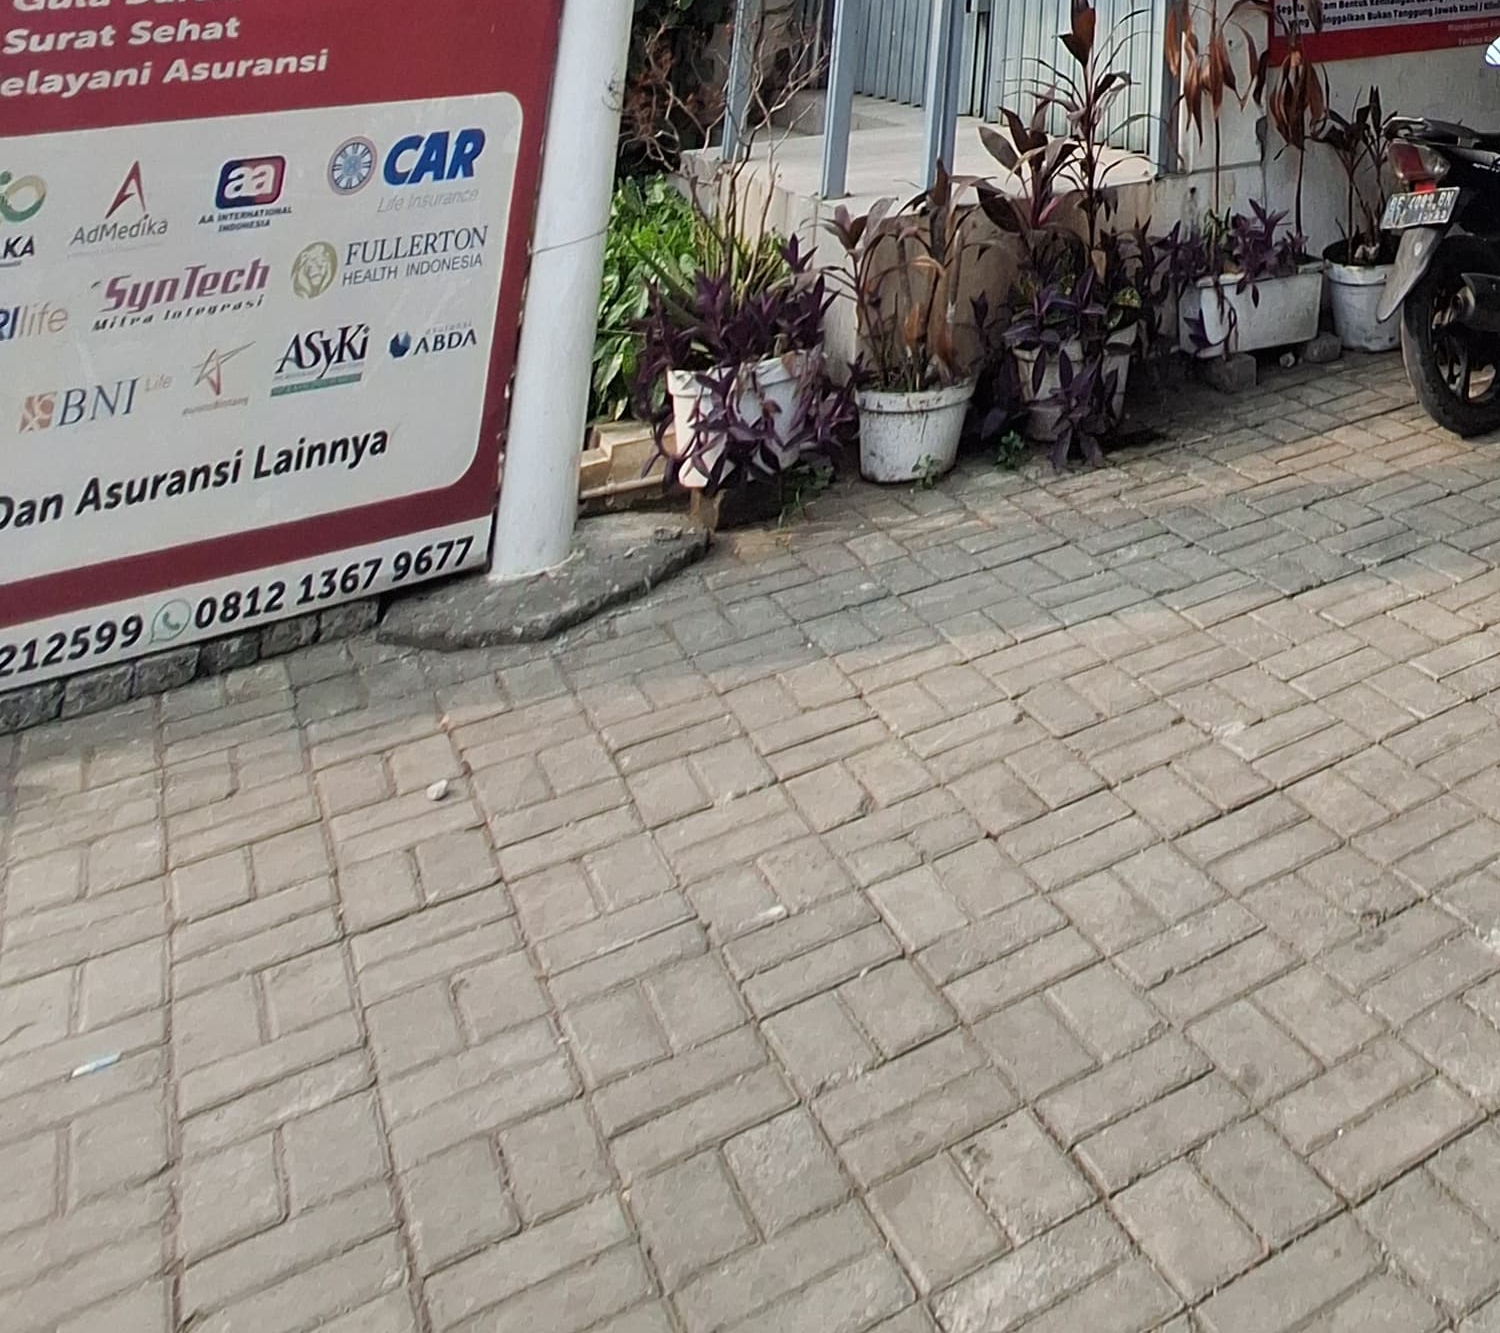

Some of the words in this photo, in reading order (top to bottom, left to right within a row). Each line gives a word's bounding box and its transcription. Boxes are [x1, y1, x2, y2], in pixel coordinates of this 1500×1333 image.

[3, 24, 116, 55] Surat
[128, 17, 241, 45] Sehat
[163, 49, 328, 83] Asuransi
[383, 128, 487, 187] CAR
[70, 213, 168, 246] AdMedika
[345, 225, 489, 265] FULLERTON
[100, 258, 271, 314] SynTech
[342, 265, 398, 286] HEALTH
[405, 253, 482, 278] INDONESIA
[413, 329, 477, 355] ABDA
[57, 378, 141, 426] BNI
[0, 495, 63, 530] Dan
[75, 449, 243, 517] Asuransi
[253, 430, 389, 480] Lainnya
[194, 580, 285, 629] 0812
[296, 557, 384, 606] 1367
[392, 535, 475, 583] 9677
